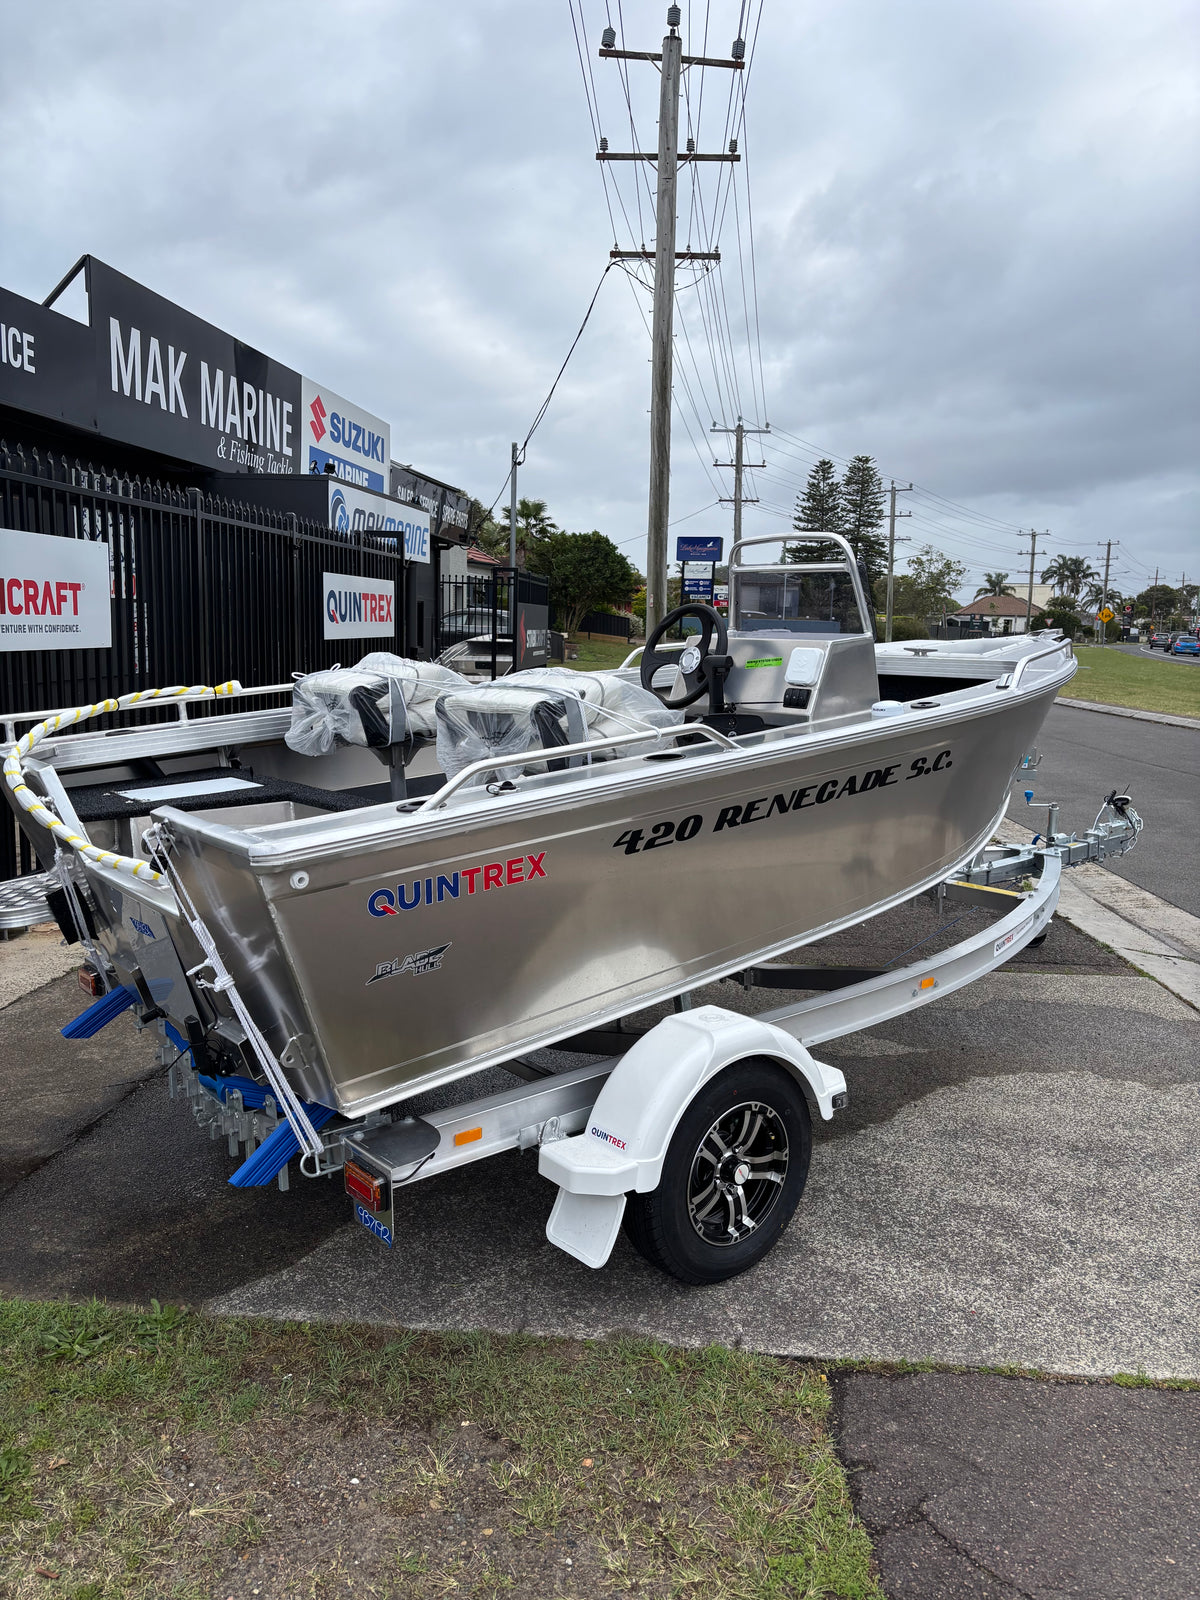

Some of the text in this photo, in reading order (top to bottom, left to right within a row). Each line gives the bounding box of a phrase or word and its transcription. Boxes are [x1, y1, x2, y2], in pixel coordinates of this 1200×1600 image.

[109, 316, 293, 456] MAK MARINE
[217, 436, 293, 474] & Fishing Tackle
[330, 412, 385, 463] SUZUKI
[327, 589, 392, 624] QUINTREX
[0, 624, 81, 634] ENTURE WITH CONFIDENCE.
[612, 750, 953, 855] 420 RENEGADE S.C.
[367, 851, 548, 918] QUINTREX
[376, 948, 445, 976] BLADE
[413, 962, 441, 976] HULL
[591, 1127, 627, 1150] QUINTREX
